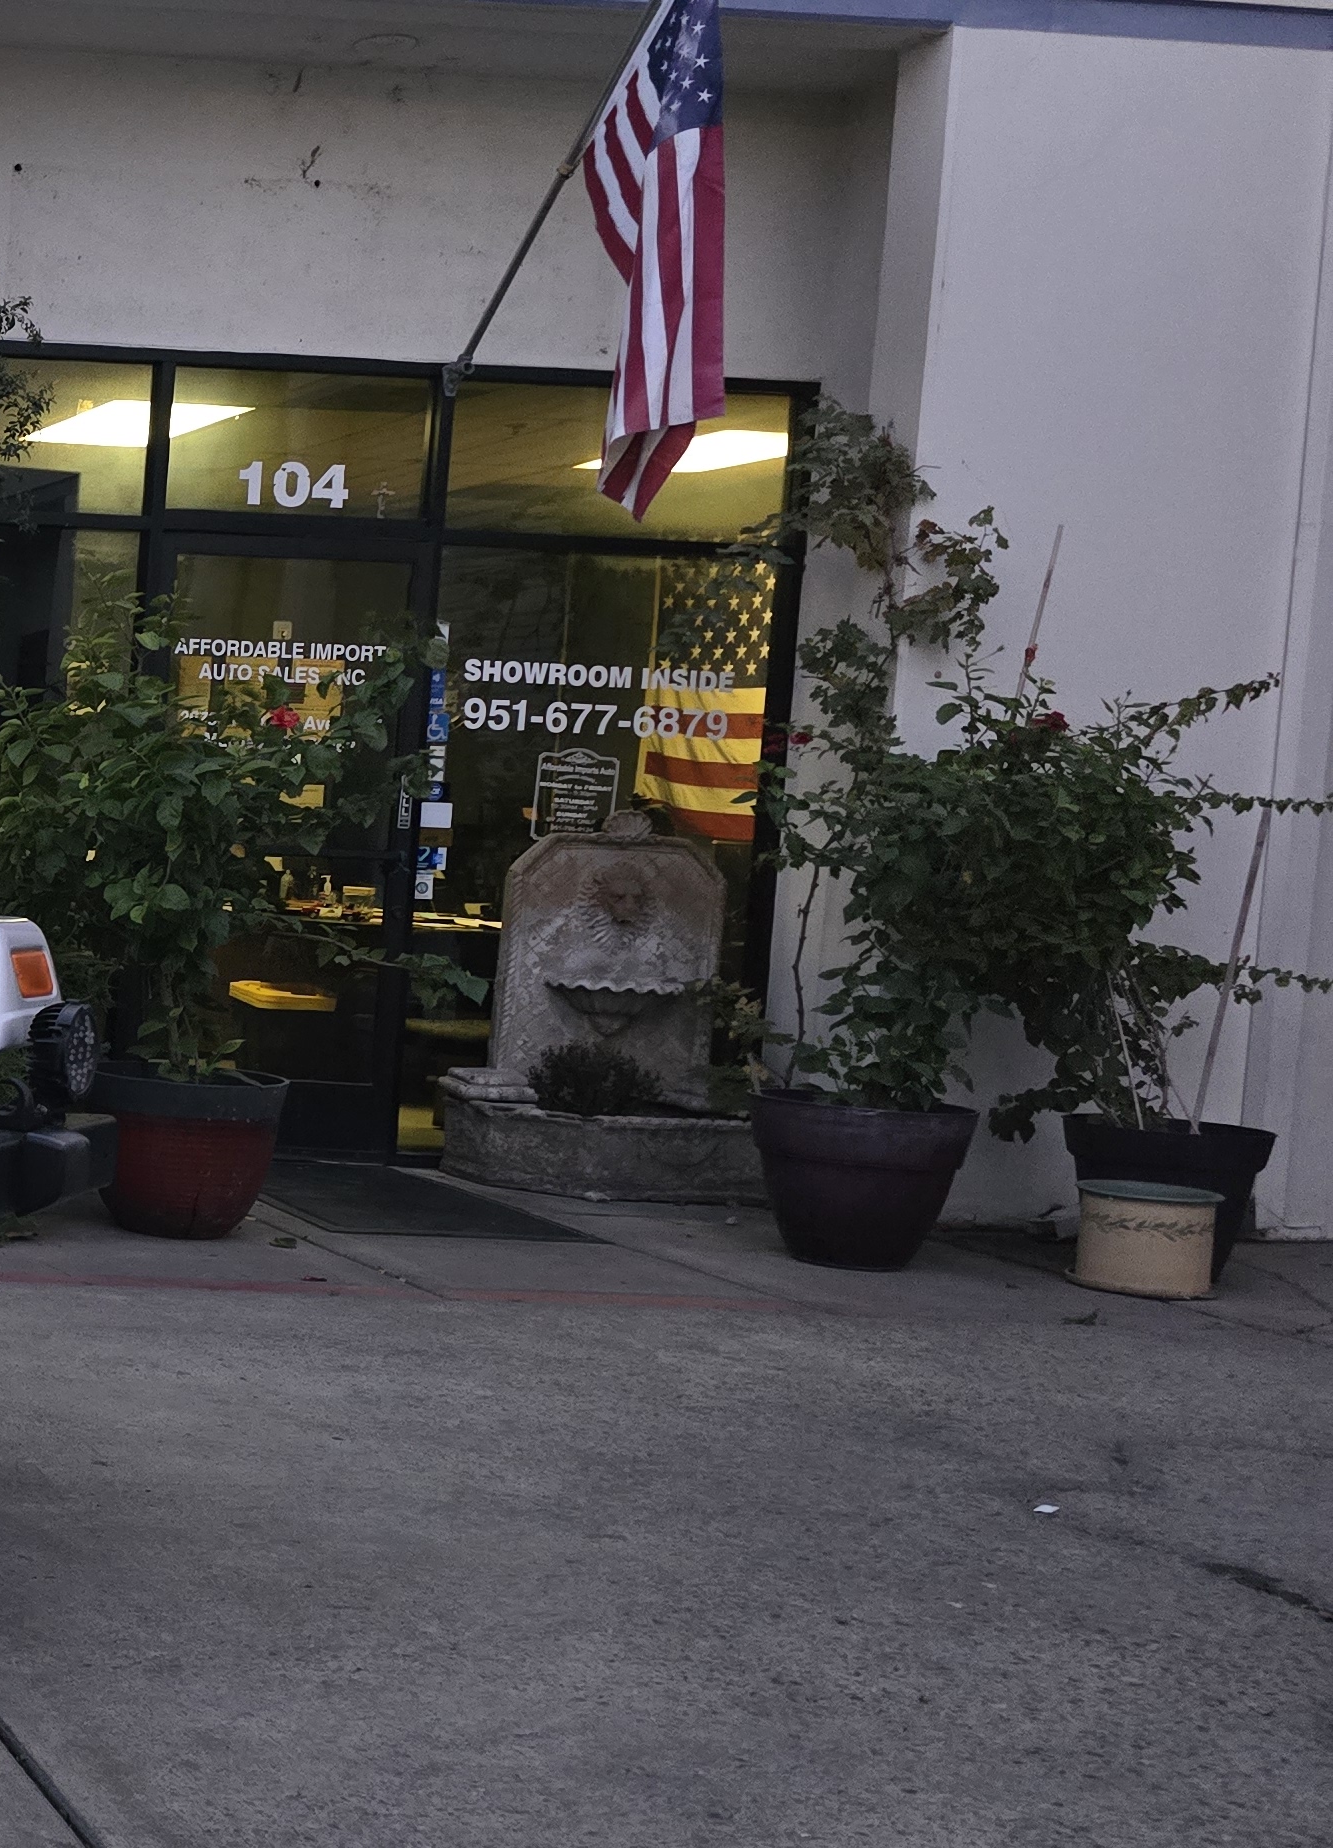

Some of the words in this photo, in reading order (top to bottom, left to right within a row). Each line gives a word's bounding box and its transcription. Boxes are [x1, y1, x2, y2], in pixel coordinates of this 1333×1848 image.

[239, 461, 349, 509] 104
[174, 638, 305, 659] AFFORDABLE
[310, 643, 389, 662] IMPORT
[199, 662, 253, 681] AUTO
[332, 668, 366, 686] NC
[464, 658, 633, 689] SHOWROOM
[641, 667, 735, 693] INSIDE
[463, 697, 728, 741] 951-677-6879
